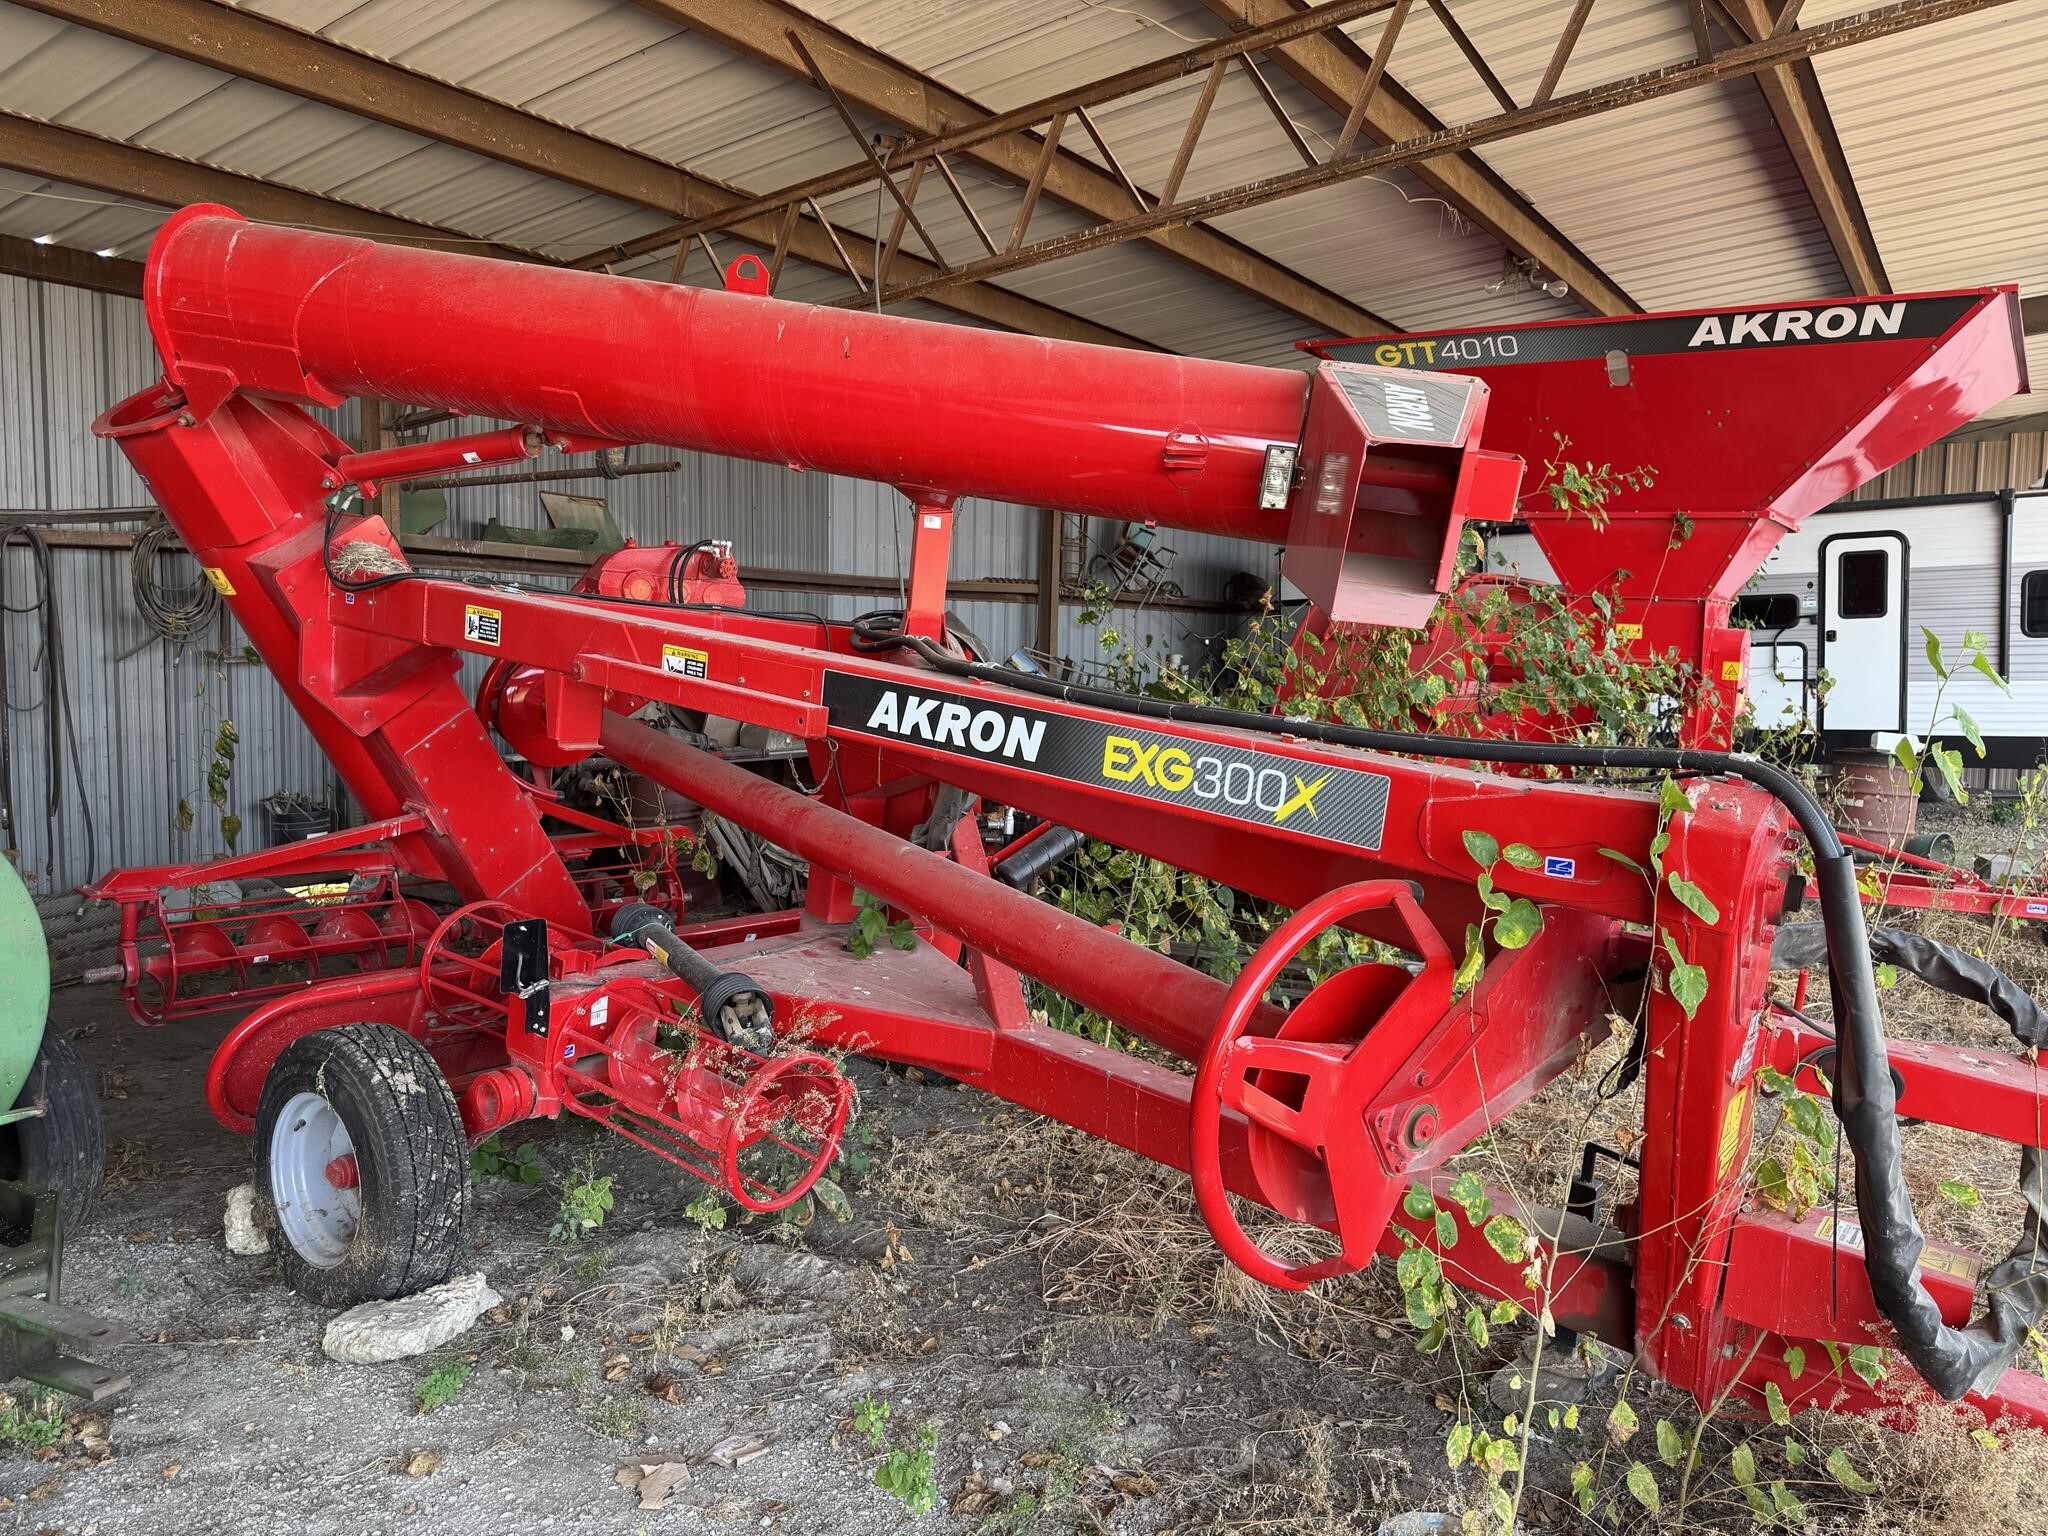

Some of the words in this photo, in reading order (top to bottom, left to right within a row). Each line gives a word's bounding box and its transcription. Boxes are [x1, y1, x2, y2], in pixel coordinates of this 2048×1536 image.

[1688, 302, 1906, 347] AKRON
[677, 651, 698, 660] WARNING
[867, 691, 1046, 762] AKRON
